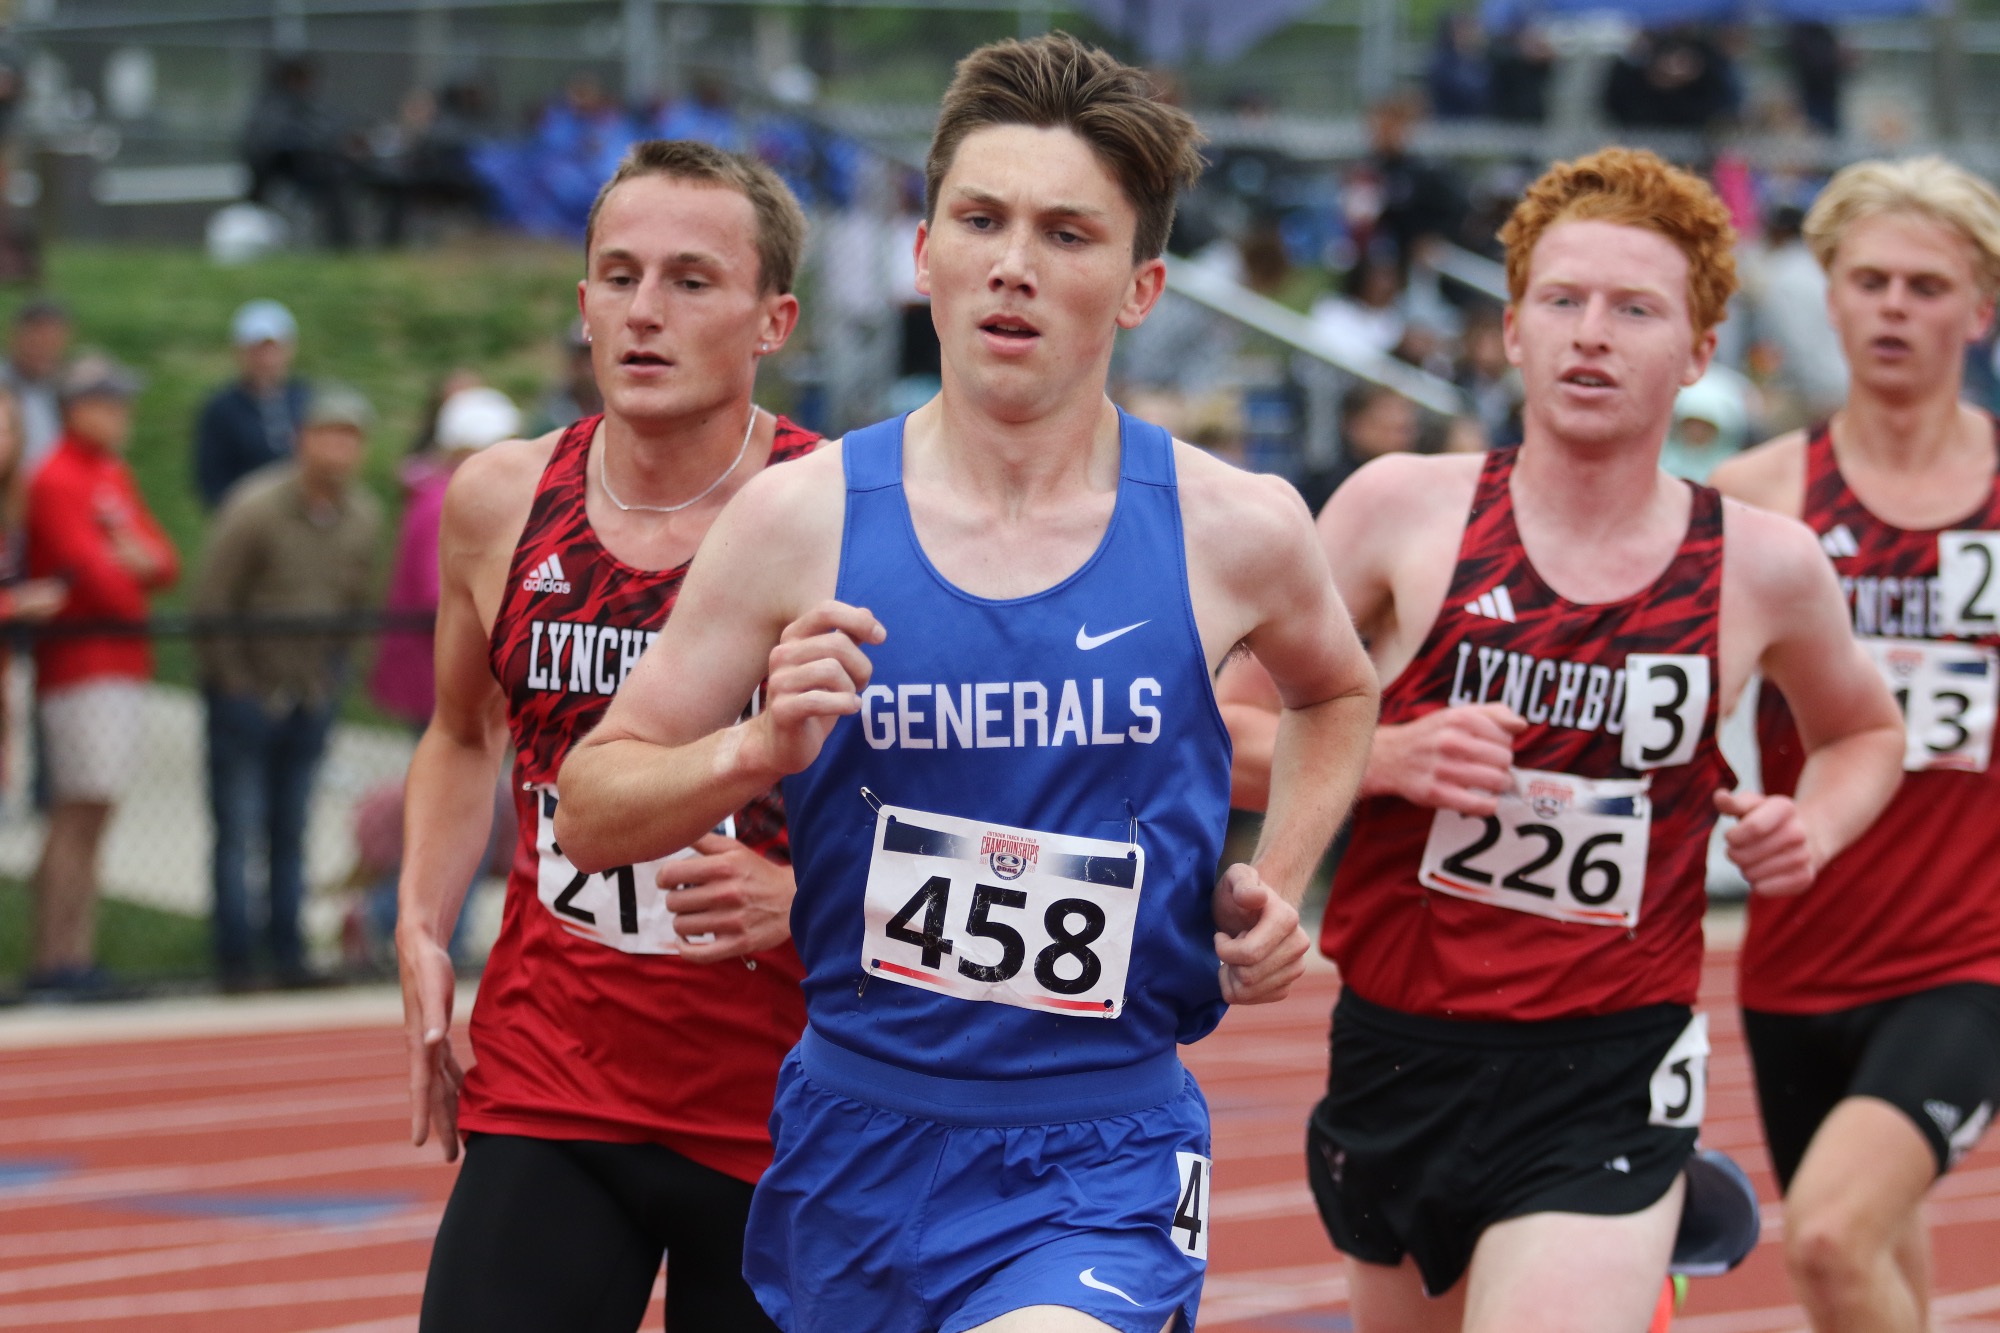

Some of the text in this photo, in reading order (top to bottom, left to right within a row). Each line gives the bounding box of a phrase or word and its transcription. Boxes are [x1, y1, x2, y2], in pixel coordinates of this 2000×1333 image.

[523, 578, 571, 594] adidas
[1961, 543, 1995, 620] 2
[527, 620, 660, 695] LYNCH
[861, 677, 1162, 750] GENERALS
[1642, 664, 1689, 761] 3
[981, 836, 1040, 865] CHAMPIONSHIPS
[986, 830, 1006, 840] OUTDOOR
[1006, 834, 1020, 842] TRACK
[1440, 814, 1624, 905] 226
[885, 875, 1106, 995] 458
[1173, 1161, 1202, 1251] 4
